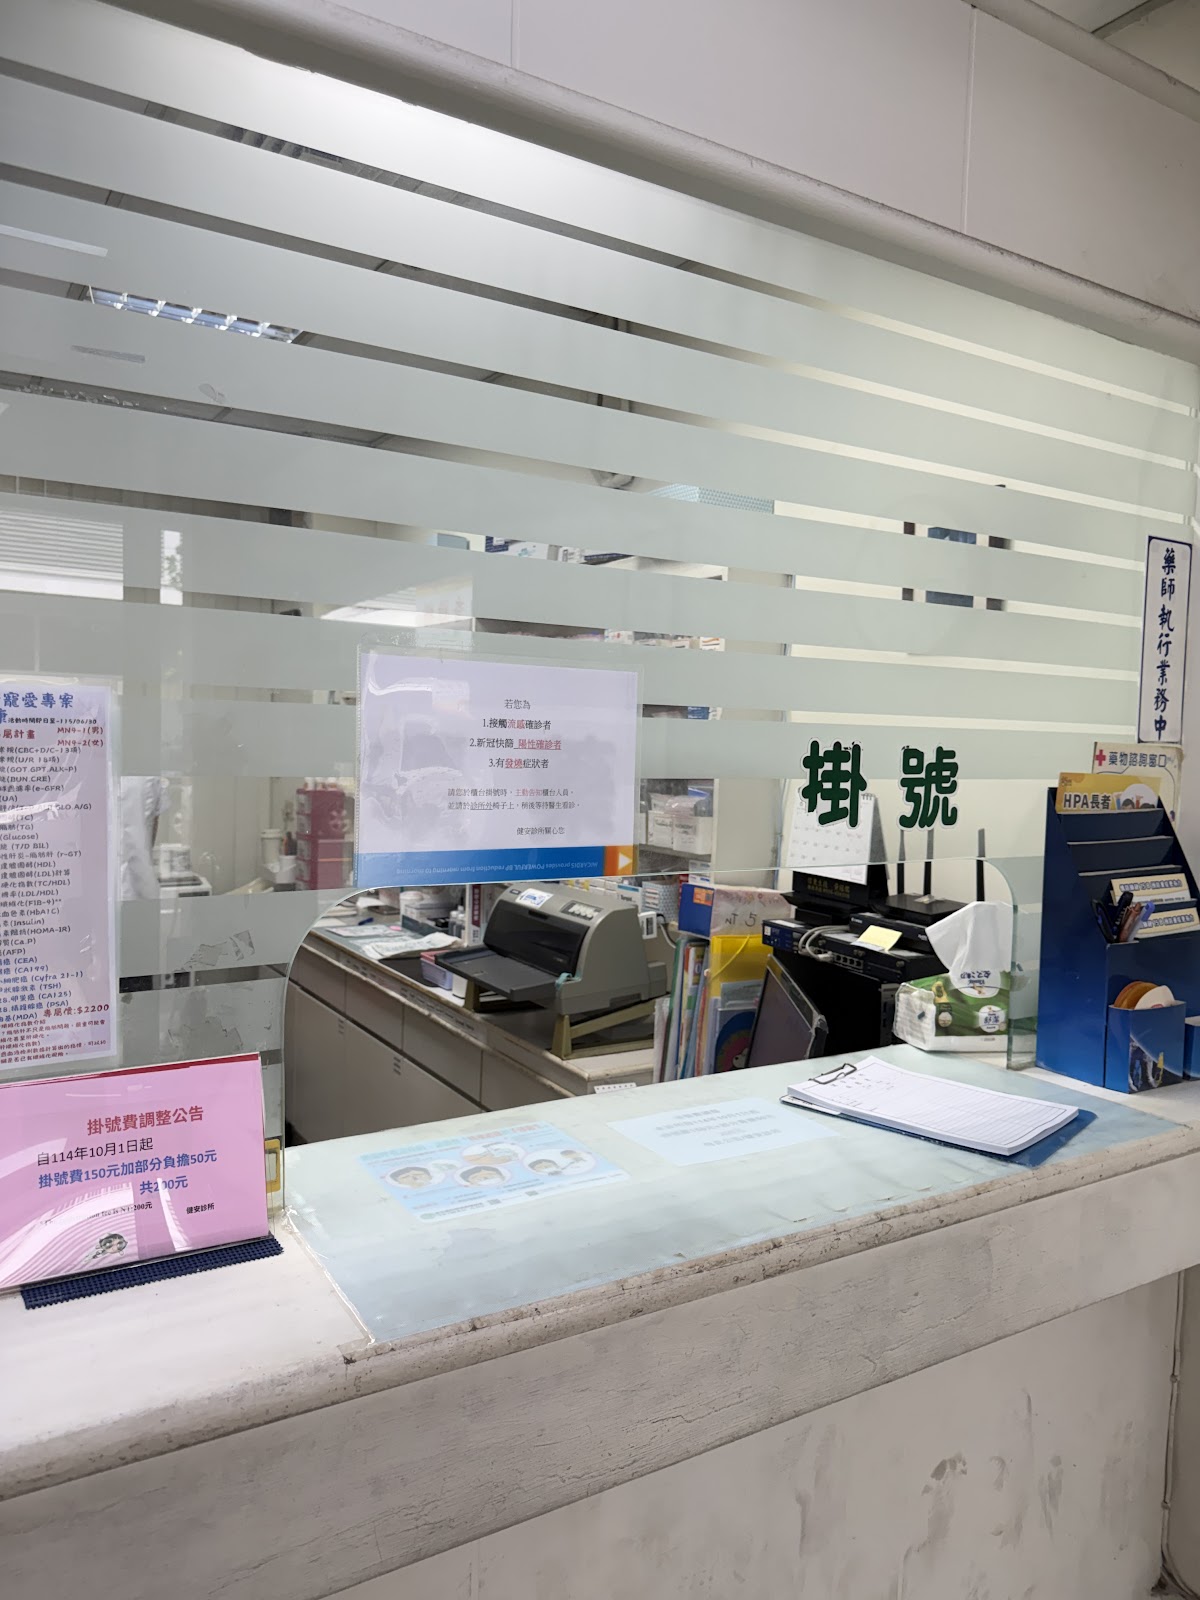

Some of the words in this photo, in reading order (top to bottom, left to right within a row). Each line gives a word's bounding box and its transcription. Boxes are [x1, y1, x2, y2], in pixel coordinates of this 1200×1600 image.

[1154, 548, 1176, 740] 藥師執行業務中
[0, 692, 73, 708] 寵愛專案
[504, 700, 530, 710] 若您為
[483, 718, 551, 730] 1.接觸流感確診者
[0, 729, 35, 740] 屬計畫
[489, 758, 549, 769] 3.有發燒症狀者
[1109, 752, 1166, 767] 藥物諮詢窗口
[801, 738, 959, 829] 掛號
[1064, 794, 1111, 809] HPA長者
[517, 827, 565, 835] 健安診所關心您
[0, 908, 59, 918] 血色素(HbA1C)
[0, 918, 44, 927] 素(Insulin)
[0, 926, 70, 937] 素阻抗(HOMA-IR)
[0, 948, 25, 956] (AFP)
[87, 1105, 204, 1136] 掛號費調整公告
[38, 1138, 154, 1166] 自114年10月1日起
[38, 1150, 217, 1189] 掛號費150元加部分負擔50元
[186, 1202, 215, 1214] 健安診所
